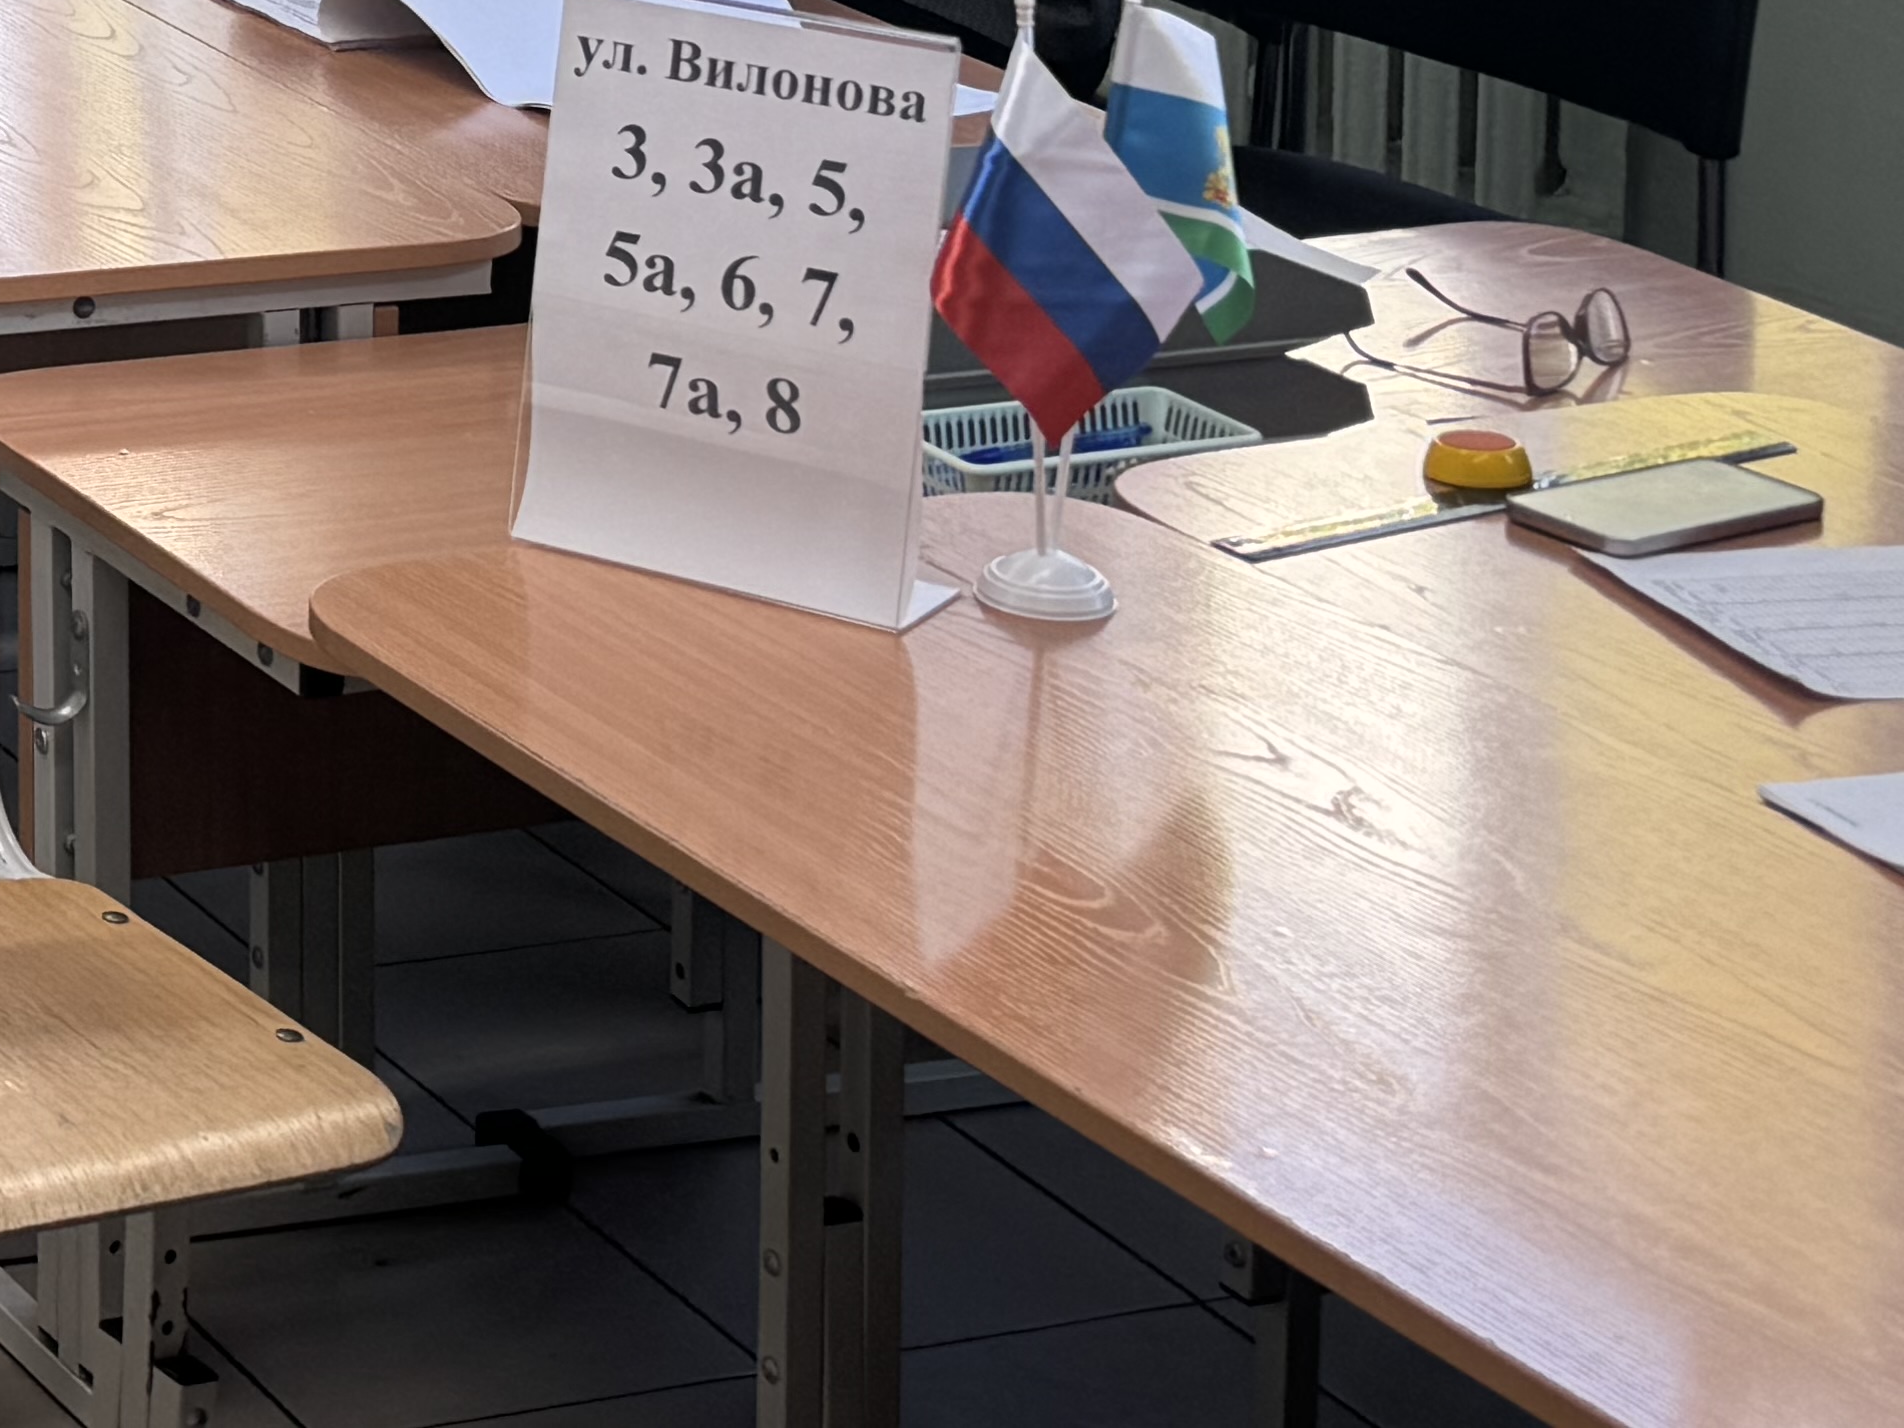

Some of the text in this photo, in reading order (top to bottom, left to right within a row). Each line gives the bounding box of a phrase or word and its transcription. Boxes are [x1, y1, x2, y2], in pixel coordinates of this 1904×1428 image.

[573, 34, 928, 124] ул. Вилонова
[610, 123, 866, 235] 3, 3а, 5,
[602, 230, 856, 345] 5а, 6, 7,
[647, 351, 802, 435] 7а, 8
